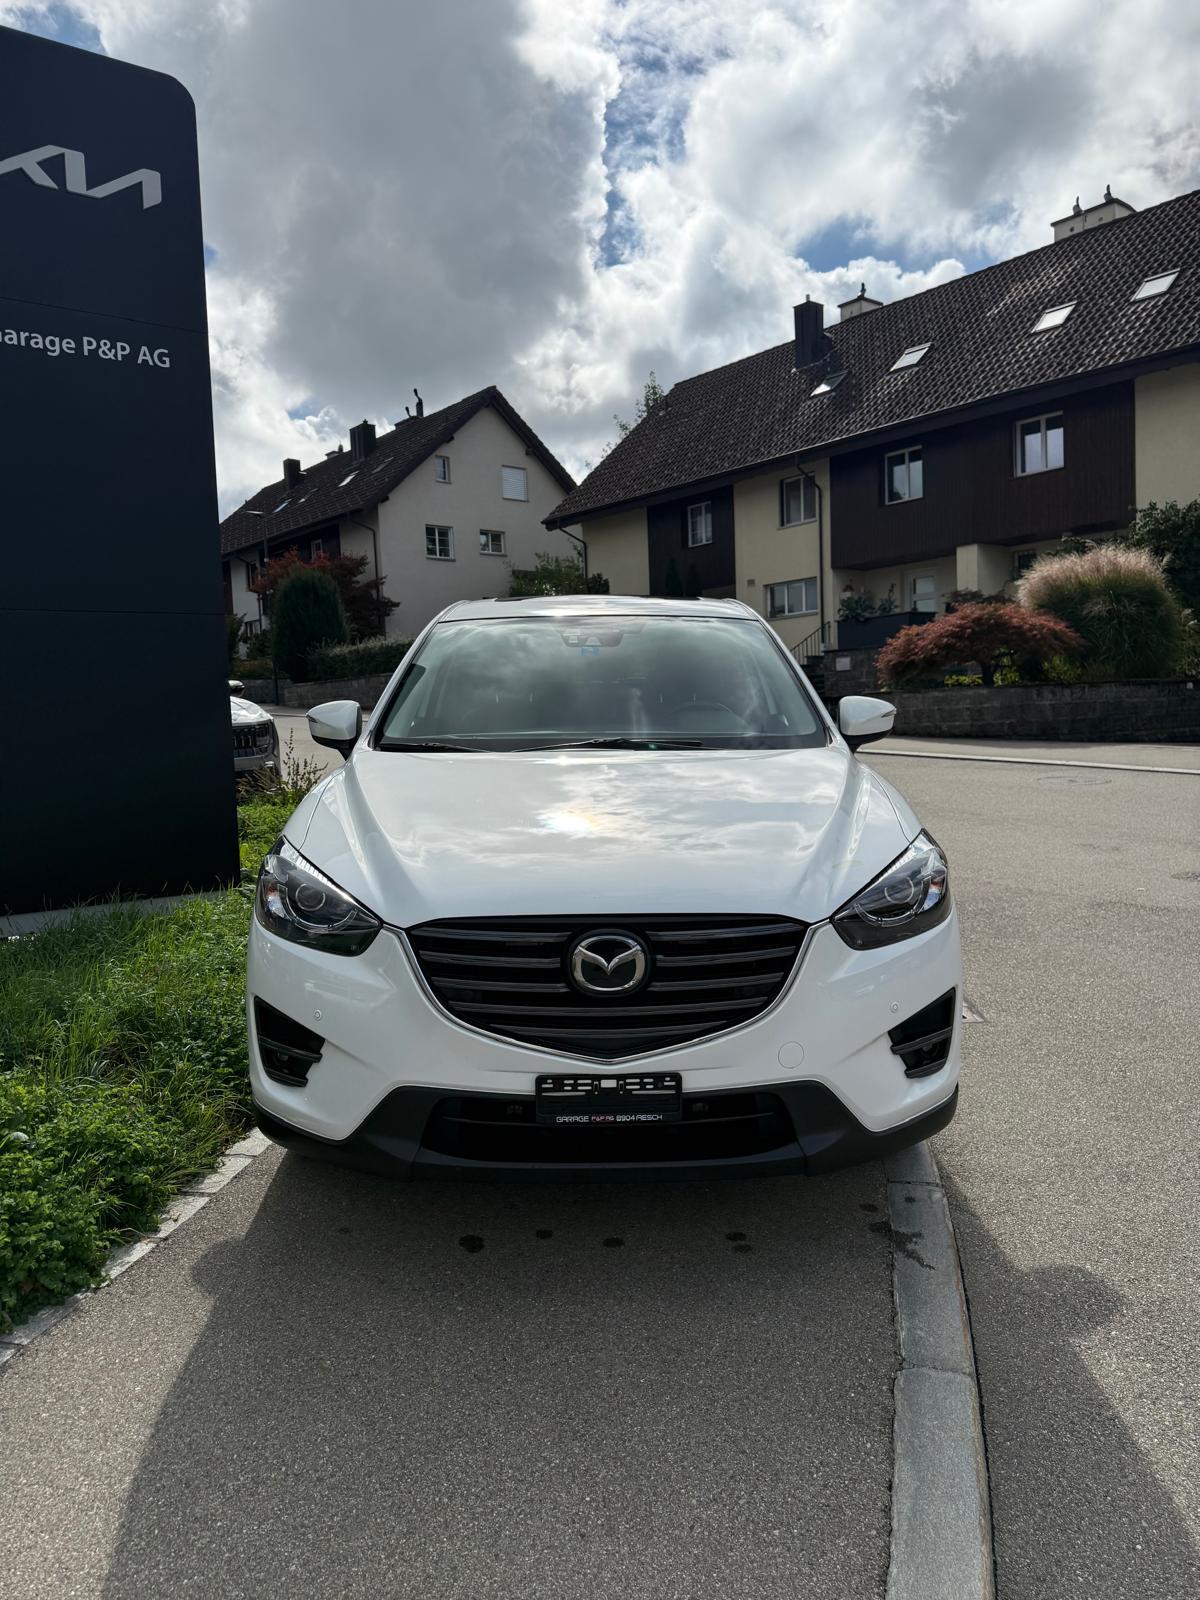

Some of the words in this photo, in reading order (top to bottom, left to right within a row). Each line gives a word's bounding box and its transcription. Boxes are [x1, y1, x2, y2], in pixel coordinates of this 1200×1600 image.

[0, 329, 75, 356] arage
[82, 336, 131, 361] P&P
[137, 345, 170, 368] AG
[556, 1115, 589, 1123] GARAGE
[616, 1114, 635, 1122] 8904
[636, 1113, 663, 1121] AESCH
